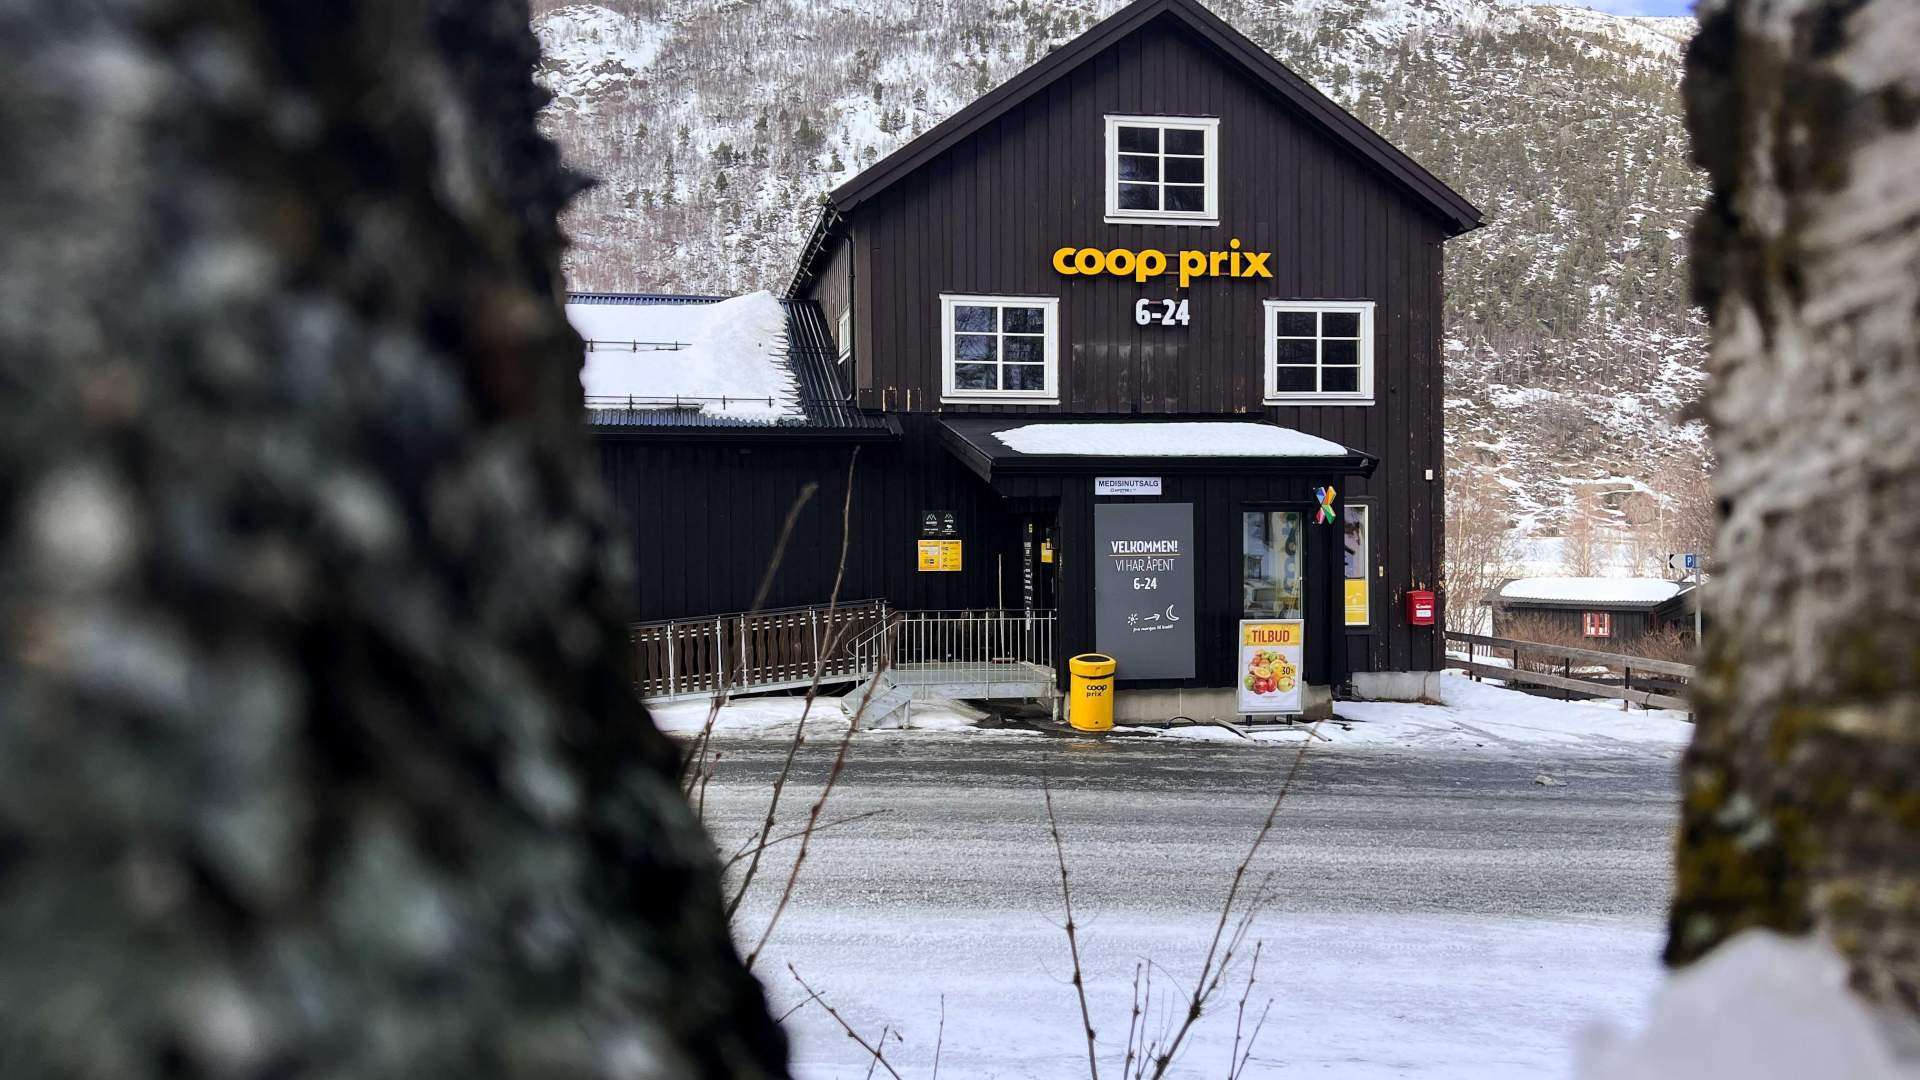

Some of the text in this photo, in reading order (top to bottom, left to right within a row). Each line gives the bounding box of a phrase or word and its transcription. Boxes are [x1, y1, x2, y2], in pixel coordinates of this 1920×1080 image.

[1053, 238, 1273, 288] coop prix
[1135, 298, 1190, 326] 6-24
[1098, 480, 1159, 488] MEDISINUTSALG
[1111, 540, 1178, 554] VELKOMMEN!
[1115, 556, 1175, 572] VI HAR ÅPENT
[1687, 556, 1692, 566] P
[1133, 577, 1157, 590] 6-24
[1252, 630, 1290, 643] TILBUD
[1086, 684, 1107, 692] coop
[1086, 690, 1102, 698] prix
